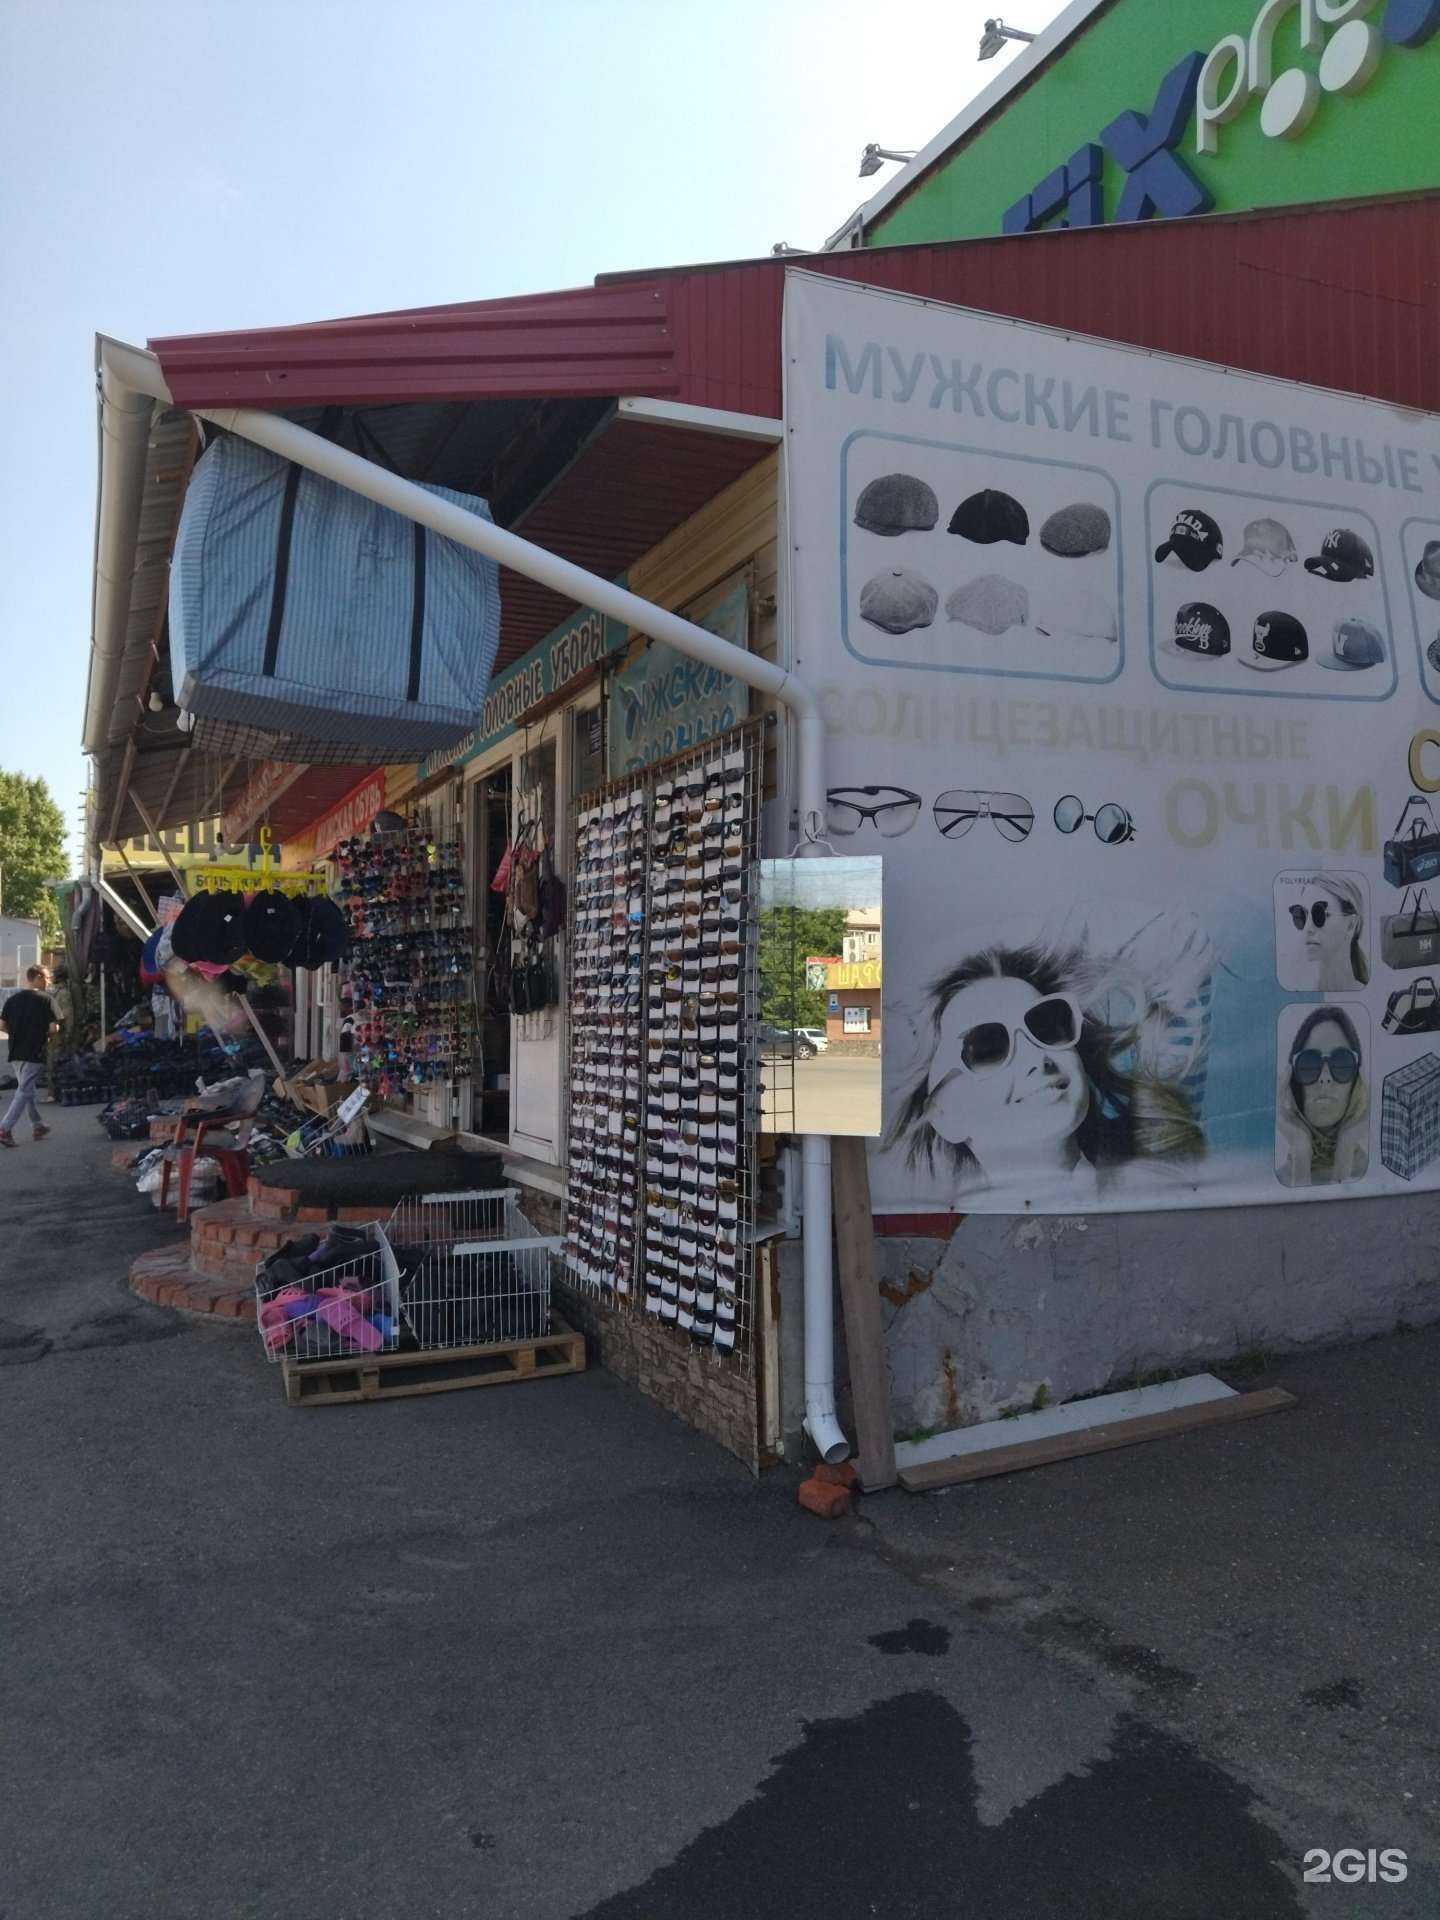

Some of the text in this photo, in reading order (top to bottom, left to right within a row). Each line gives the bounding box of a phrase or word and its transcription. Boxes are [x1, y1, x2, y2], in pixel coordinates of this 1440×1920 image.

[825, 333, 1425, 493] МУЖСКИЕ ГОЛОВНЫЕ
[479, 658, 544, 742] ГОЛОВНЫЕ
[551, 613, 607, 692] УБОРЫ
[822, 685, 1309, 763] СОЛНЦЕЗАЩИТНЫЕ
[1165, 777, 1379, 857] ОЧКИ
